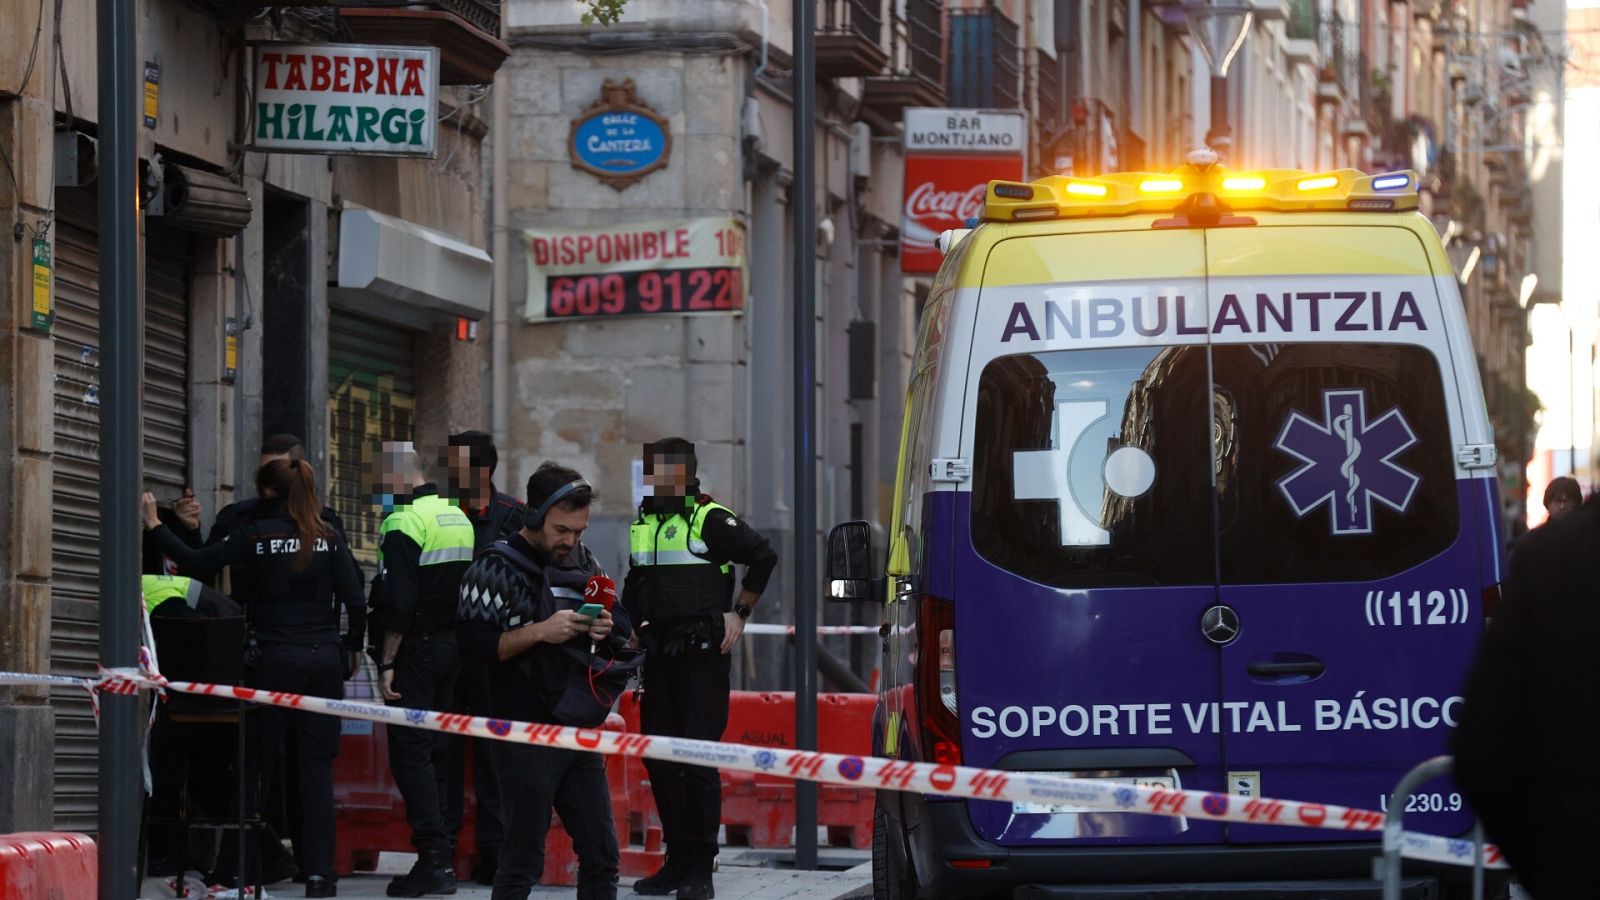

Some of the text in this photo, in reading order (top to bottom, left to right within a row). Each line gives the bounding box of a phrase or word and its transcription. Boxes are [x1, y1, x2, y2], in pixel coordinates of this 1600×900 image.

[262, 53, 425, 97] TABERNA
[602, 115, 638, 125] CALLE
[606, 128, 636, 136] DE LA
[946, 117, 981, 130] BAR
[912, 132, 1013, 146] MONTIJANO
[534, 229, 690, 266] DISPONIBLE
[551, 273, 625, 316] 609
[1001, 291, 1428, 342] ANBULANTZIA
[971, 703, 1173, 739] SOPORTE
[1182, 700, 1302, 734] VITAL
[1405, 792, 1462, 813] 230.9
